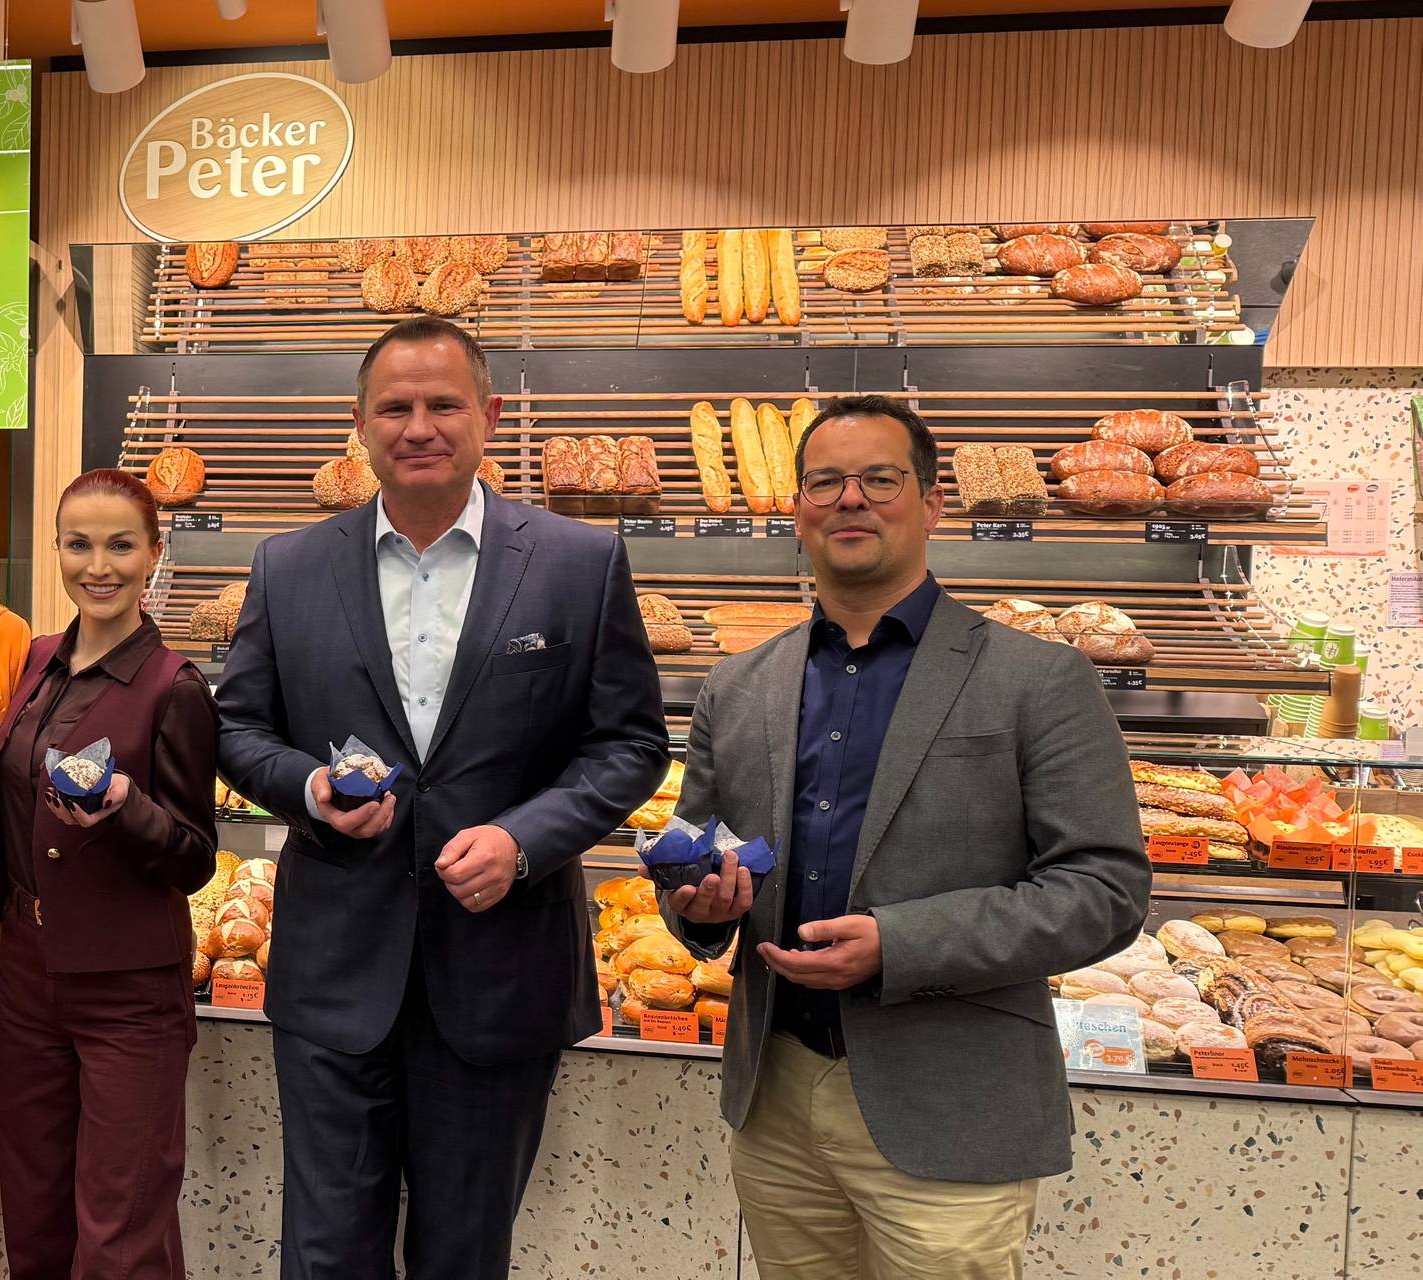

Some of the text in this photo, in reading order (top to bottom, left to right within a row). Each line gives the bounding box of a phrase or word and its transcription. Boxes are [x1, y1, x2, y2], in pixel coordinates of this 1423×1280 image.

[191, 113, 326, 149] Bäcker
[146, 140, 322, 200] Peter
[1339, 846, 1378, 855] Apflmuffin
